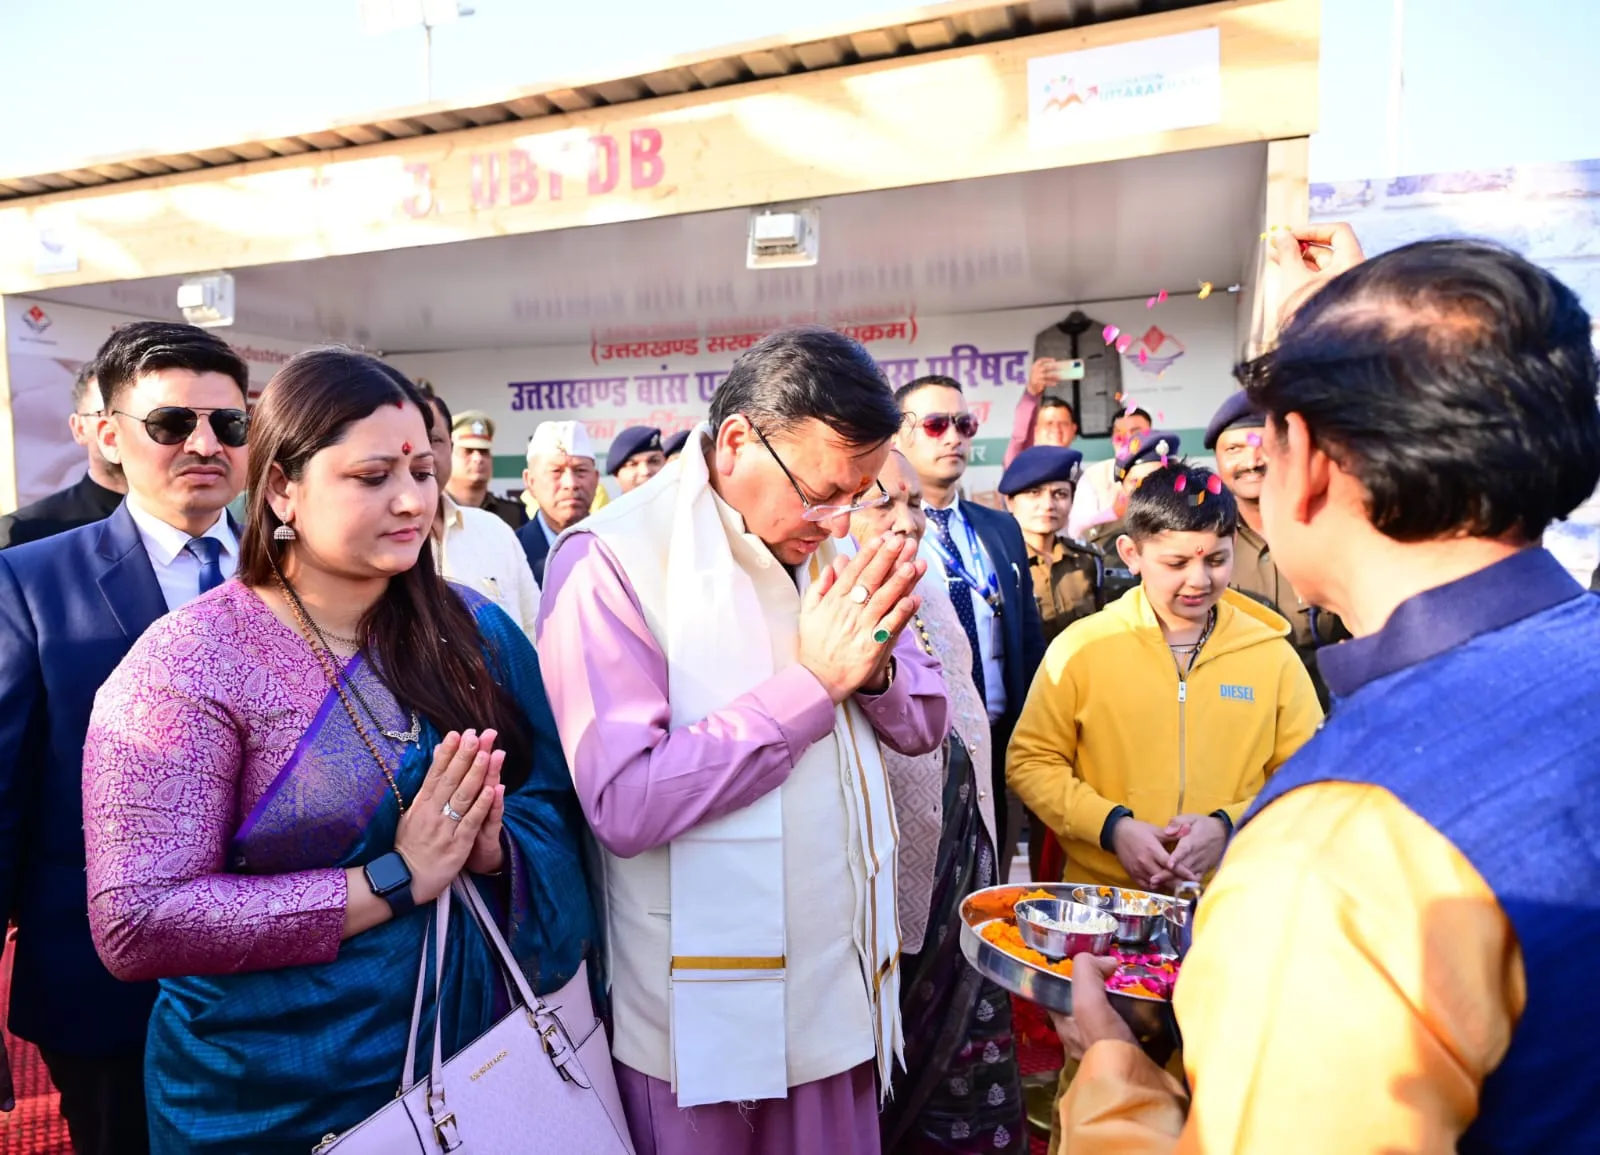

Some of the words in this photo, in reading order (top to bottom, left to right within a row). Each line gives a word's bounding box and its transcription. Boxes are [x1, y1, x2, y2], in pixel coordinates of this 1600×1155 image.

[840, 316, 918, 344] पक्रम)
[508, 376, 629, 411] उत्तराखण्ड
[1220, 684, 1254, 701] DIESEL
